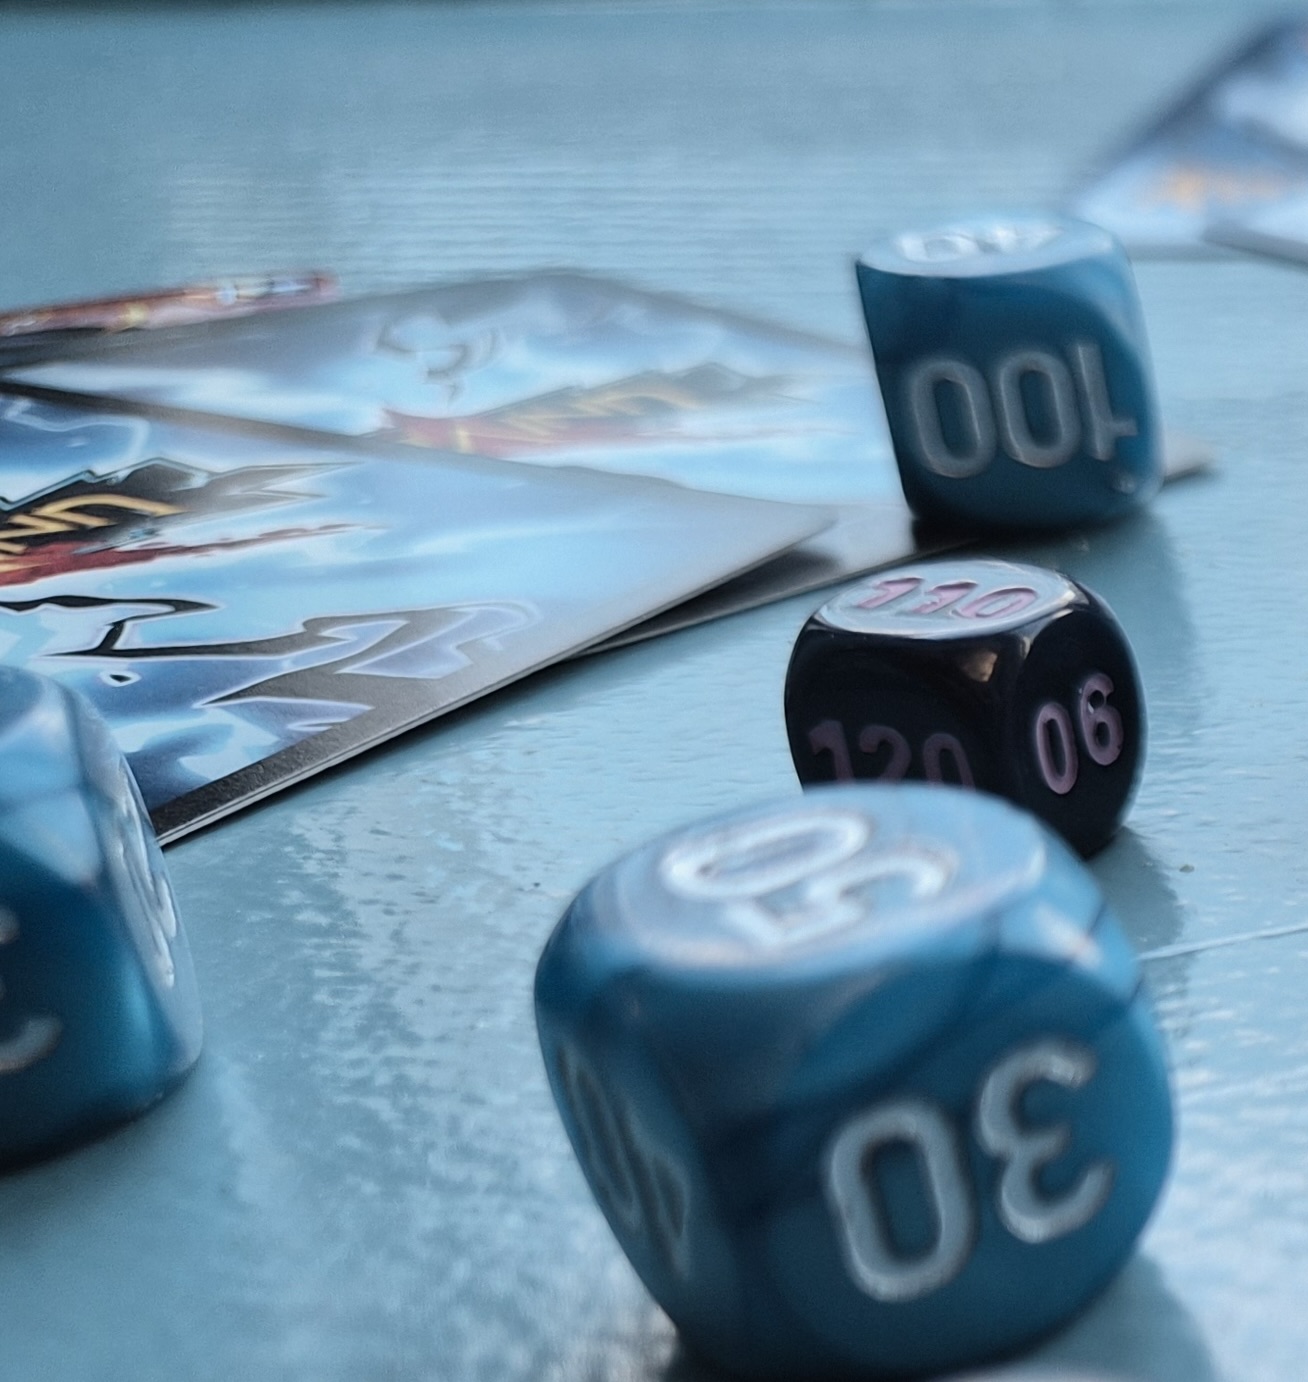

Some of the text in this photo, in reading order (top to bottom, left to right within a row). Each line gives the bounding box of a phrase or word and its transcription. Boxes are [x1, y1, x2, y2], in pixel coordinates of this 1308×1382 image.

[909, 343, 1138, 479] 100
[857, 576, 1038, 619] 110
[658, 809, 960, 948] 50
[822, 1036, 1119, 1303] 30
